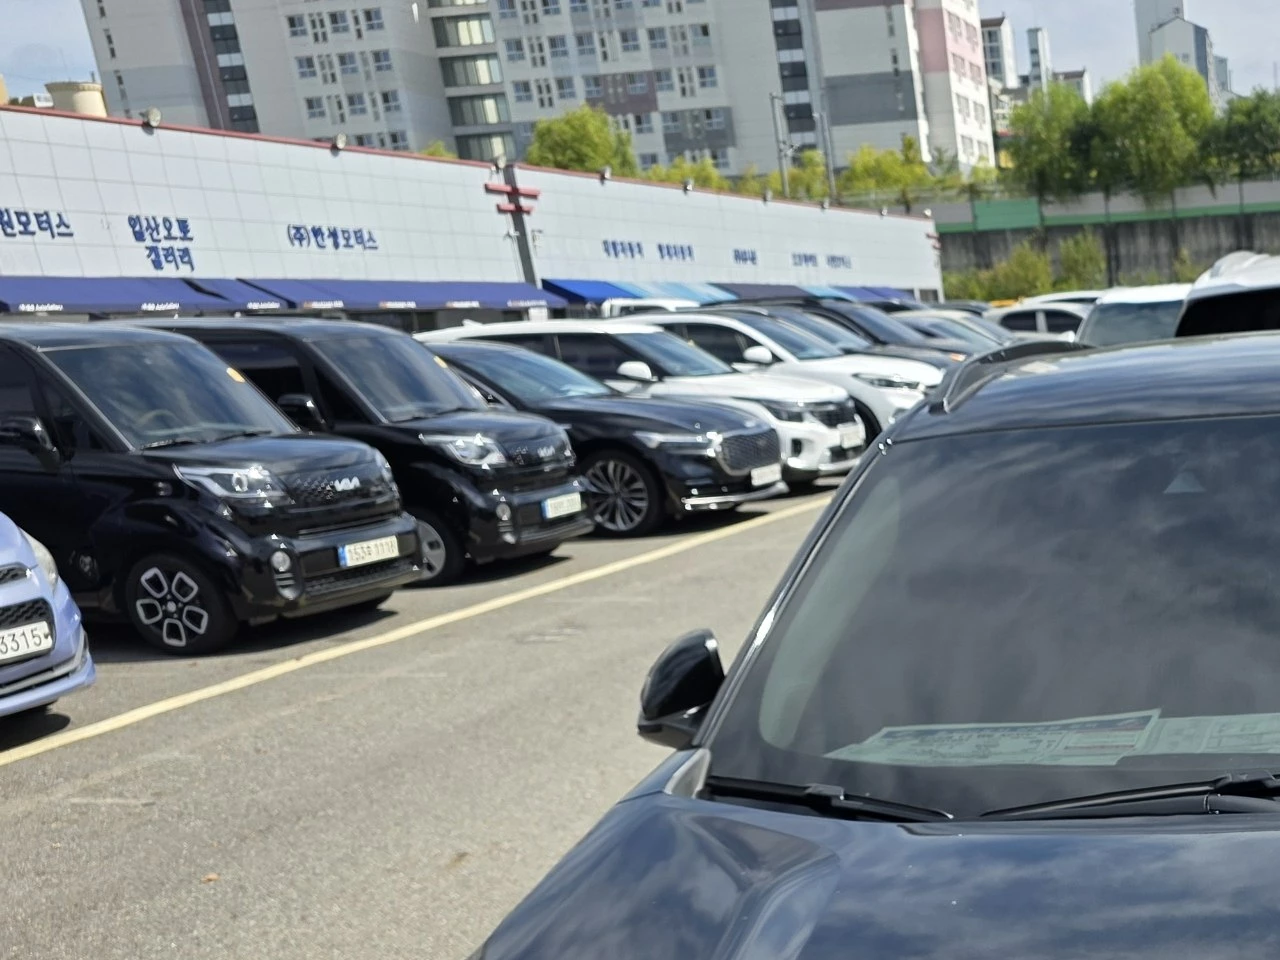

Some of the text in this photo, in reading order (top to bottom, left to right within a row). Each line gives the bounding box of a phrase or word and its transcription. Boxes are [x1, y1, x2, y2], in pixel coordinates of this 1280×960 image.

[127, 214, 193, 242] 일산오토
[145, 246, 194, 272] 갤러리
[0, 627, 42, 655] 3315
